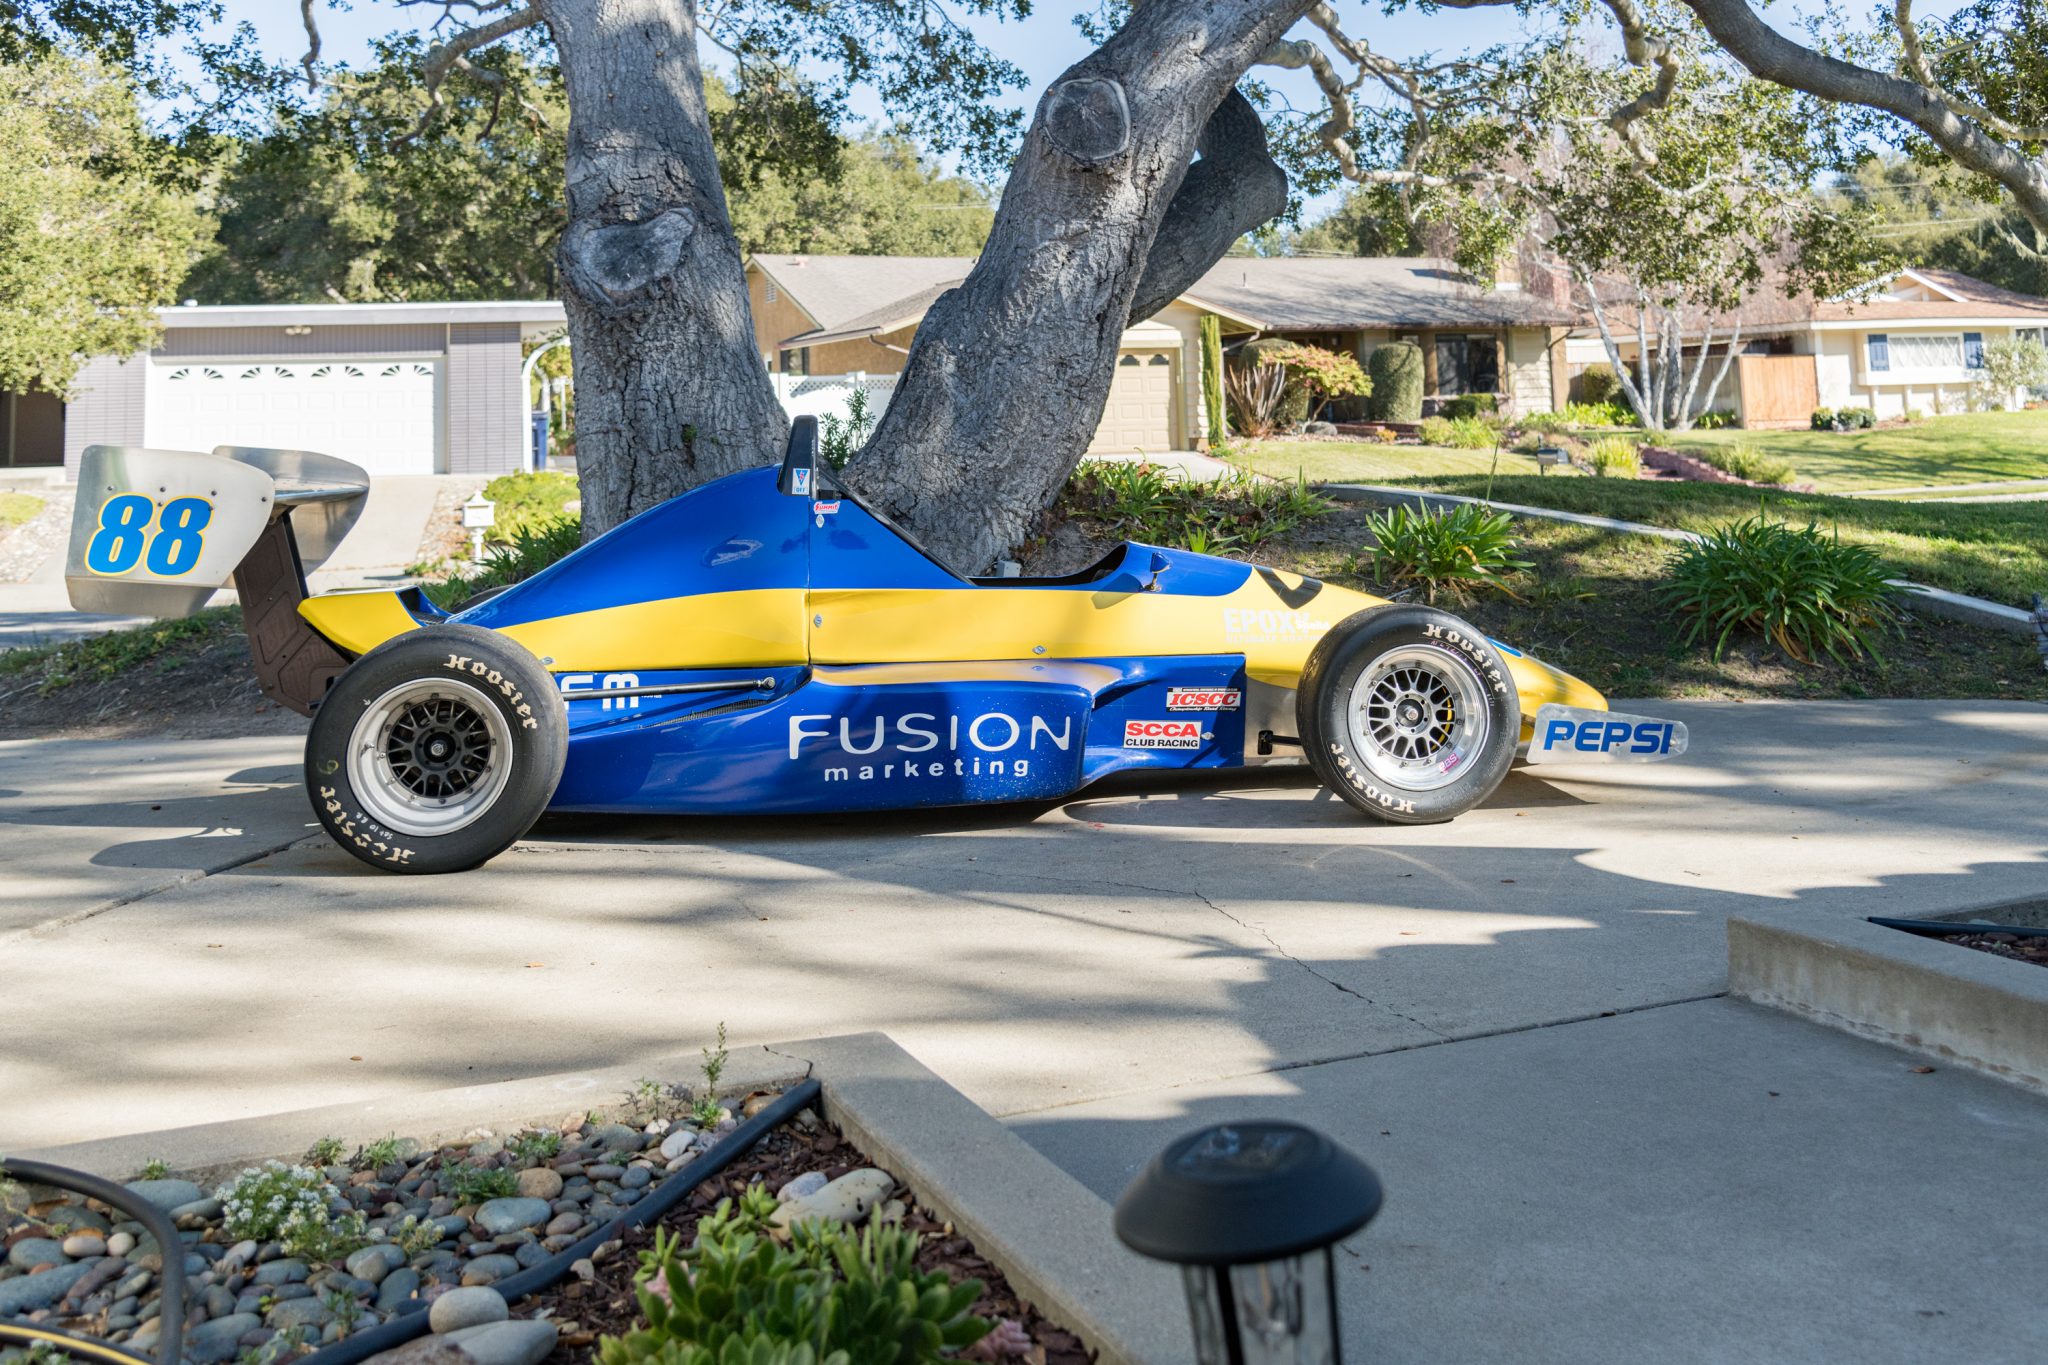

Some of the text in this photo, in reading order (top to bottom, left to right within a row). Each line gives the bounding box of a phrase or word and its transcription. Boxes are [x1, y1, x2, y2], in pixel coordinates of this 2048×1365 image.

[84, 492, 214, 578] 88
[1422, 624, 1508, 693] Hoosier
[443, 654, 538, 729] Hoosier
[1169, 692, 1238, 706] ICSCC
[789, 713, 1070, 760] FUSION
[1125, 738, 1199, 748] CLUB RACING
[1126, 722, 1199, 737] SCCA
[1543, 720, 1674, 754] PEPSI
[824, 757, 1029, 782] marketing
[1331, 743, 1417, 813] Hoosier
